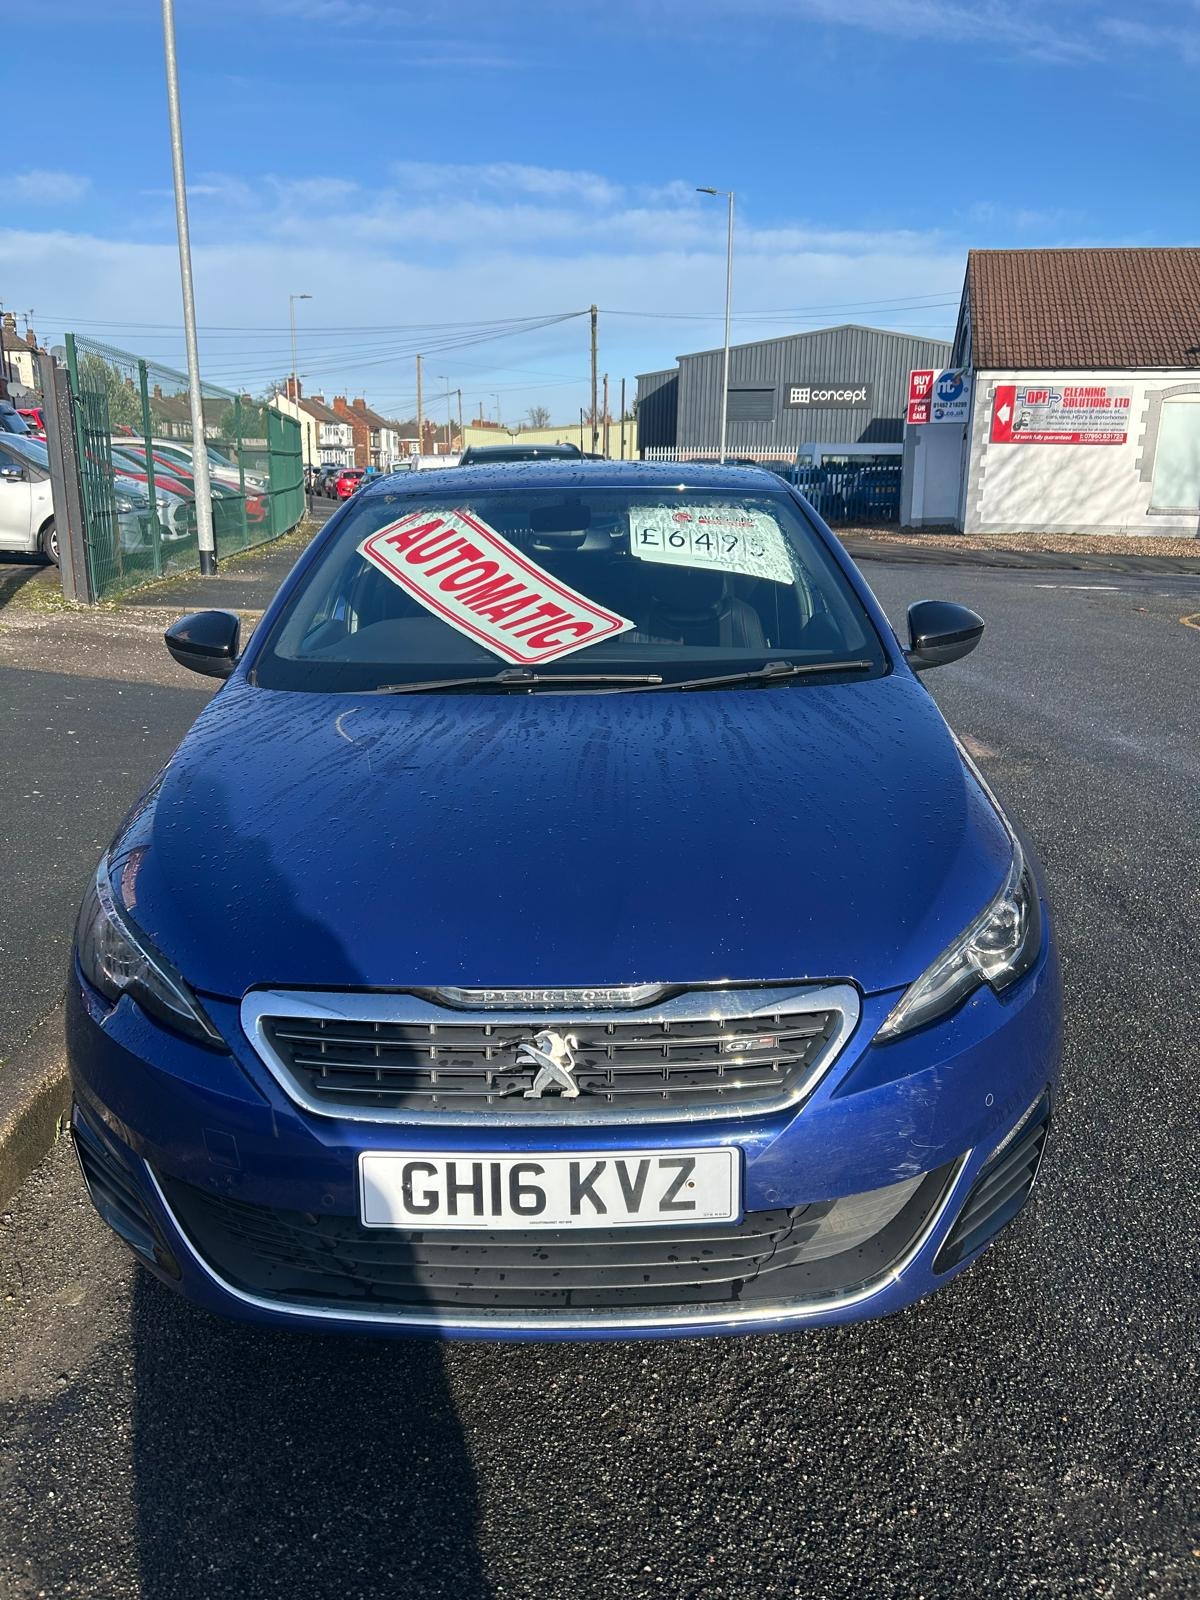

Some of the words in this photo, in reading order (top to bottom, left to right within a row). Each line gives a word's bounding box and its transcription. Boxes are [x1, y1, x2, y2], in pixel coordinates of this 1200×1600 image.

[913, 375, 931, 385] BUY
[915, 385, 927, 395] IT!
[1064, 387, 1106, 397] CLEANING
[811, 387, 866, 404] concept
[1027, 391, 1049, 404] DPF
[1062, 397, 1111, 408] SOLUTIONS
[1113, 397, 1130, 408] LTD
[914, 404, 926, 412] FOR
[912, 412, 927, 420] SALE
[385, 518, 595, 649] AUTOMATIC
[401, 1161, 547, 1217] GH16
[569, 1156, 697, 1216] KVZ
